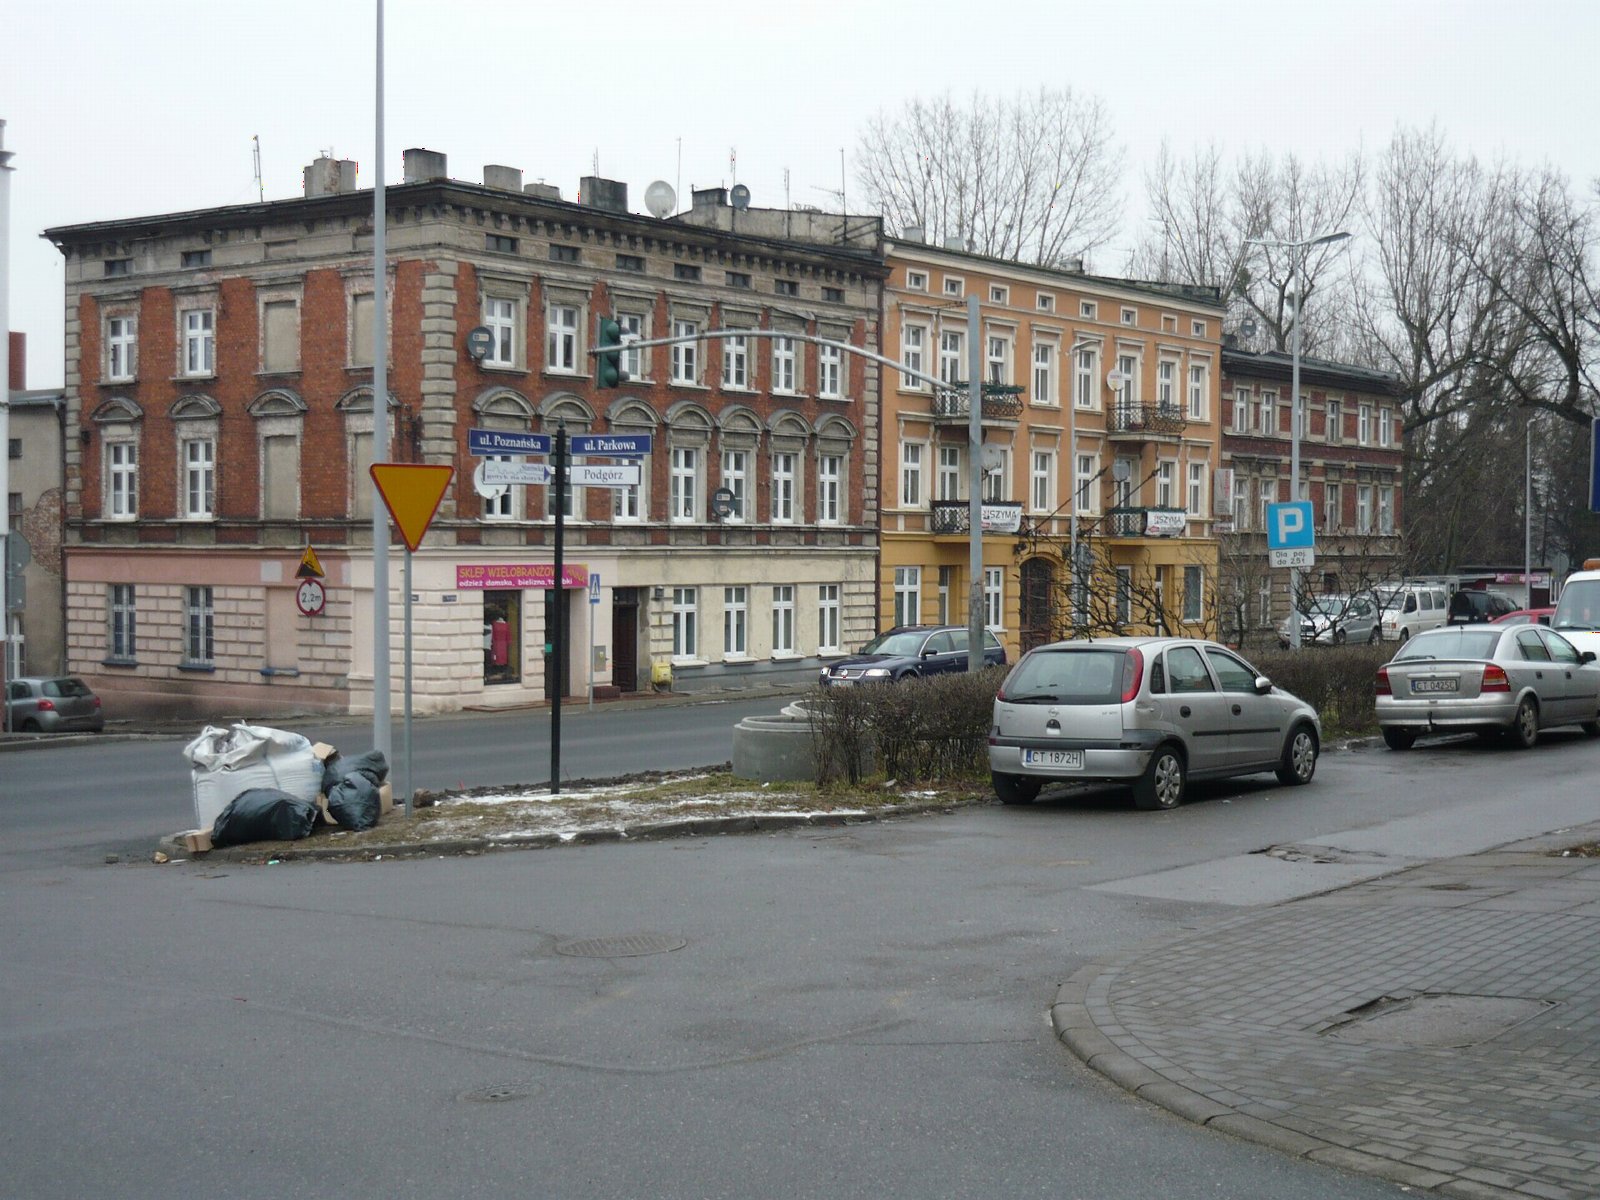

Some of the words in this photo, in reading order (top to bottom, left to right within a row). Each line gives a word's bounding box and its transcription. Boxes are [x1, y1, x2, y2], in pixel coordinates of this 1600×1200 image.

[480, 434, 492, 446] ul.
[494, 434, 542, 449] Poznańska
[584, 440, 596, 451] ul.
[598, 439, 636, 451] Parkowa
[584, 468, 624, 483] Podgórz
[1278, 508, 1303, 544] P
[1276, 558, 1287, 566] do
[460, 566, 485, 579] SKLEP
[488, 565, 555, 579] WIELOBRANŻOW
[1032, 751, 1046, 763] CT
[1049, 752, 1079, 764] 1872H
